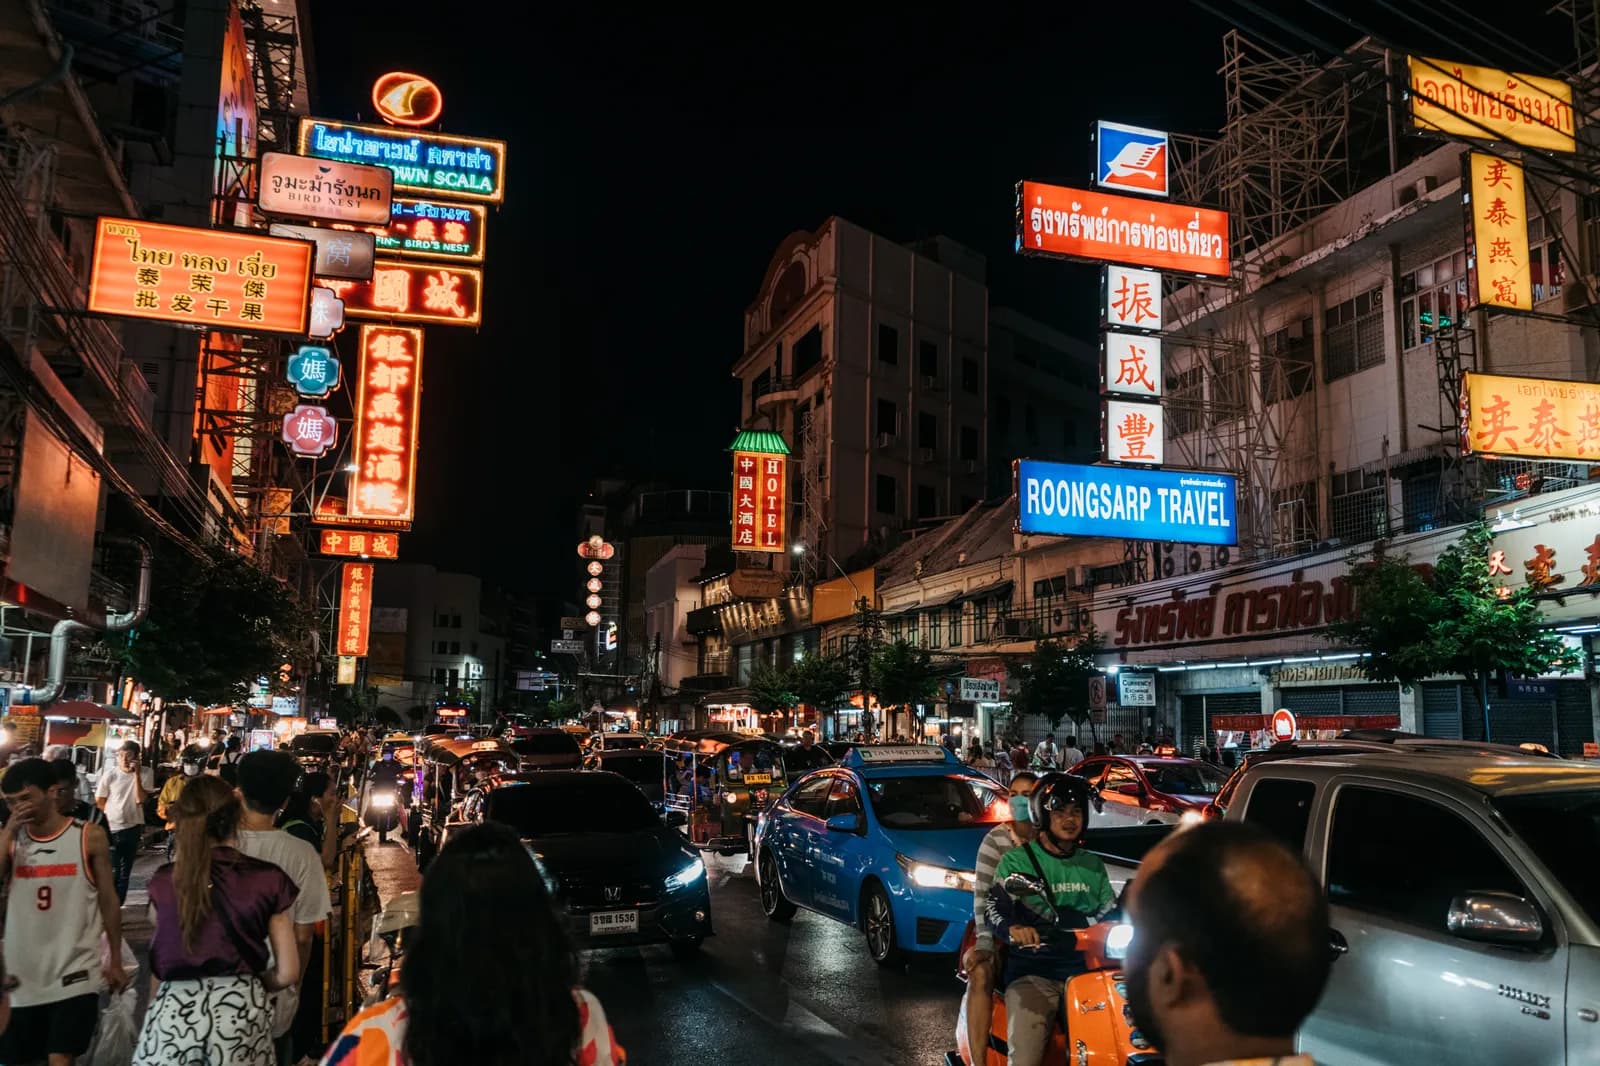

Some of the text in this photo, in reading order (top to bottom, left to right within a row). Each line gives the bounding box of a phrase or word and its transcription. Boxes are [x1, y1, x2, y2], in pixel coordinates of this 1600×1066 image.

[375, 163, 492, 191] OWN SCALA
[288, 192, 361, 209] BIRD NEST
[1031, 196, 1222, 259] รุ่งทรัพย์การท่องเที่ยว
[127, 239, 172, 266] ไทย
[180, 253, 227, 273] หลง
[443, 243, 470, 252] NEST
[738, 458, 755, 544] 中國大酒店
[767, 460, 779, 546] HOTEL
[1027, 478, 1230, 527] ROONGSARP TRAVEL
[325, 532, 391, 556] 中國城
[1222, 570, 1360, 635] การท่อง
[37, 885, 52, 911] 9
[615, 913, 635, 924] 1536
